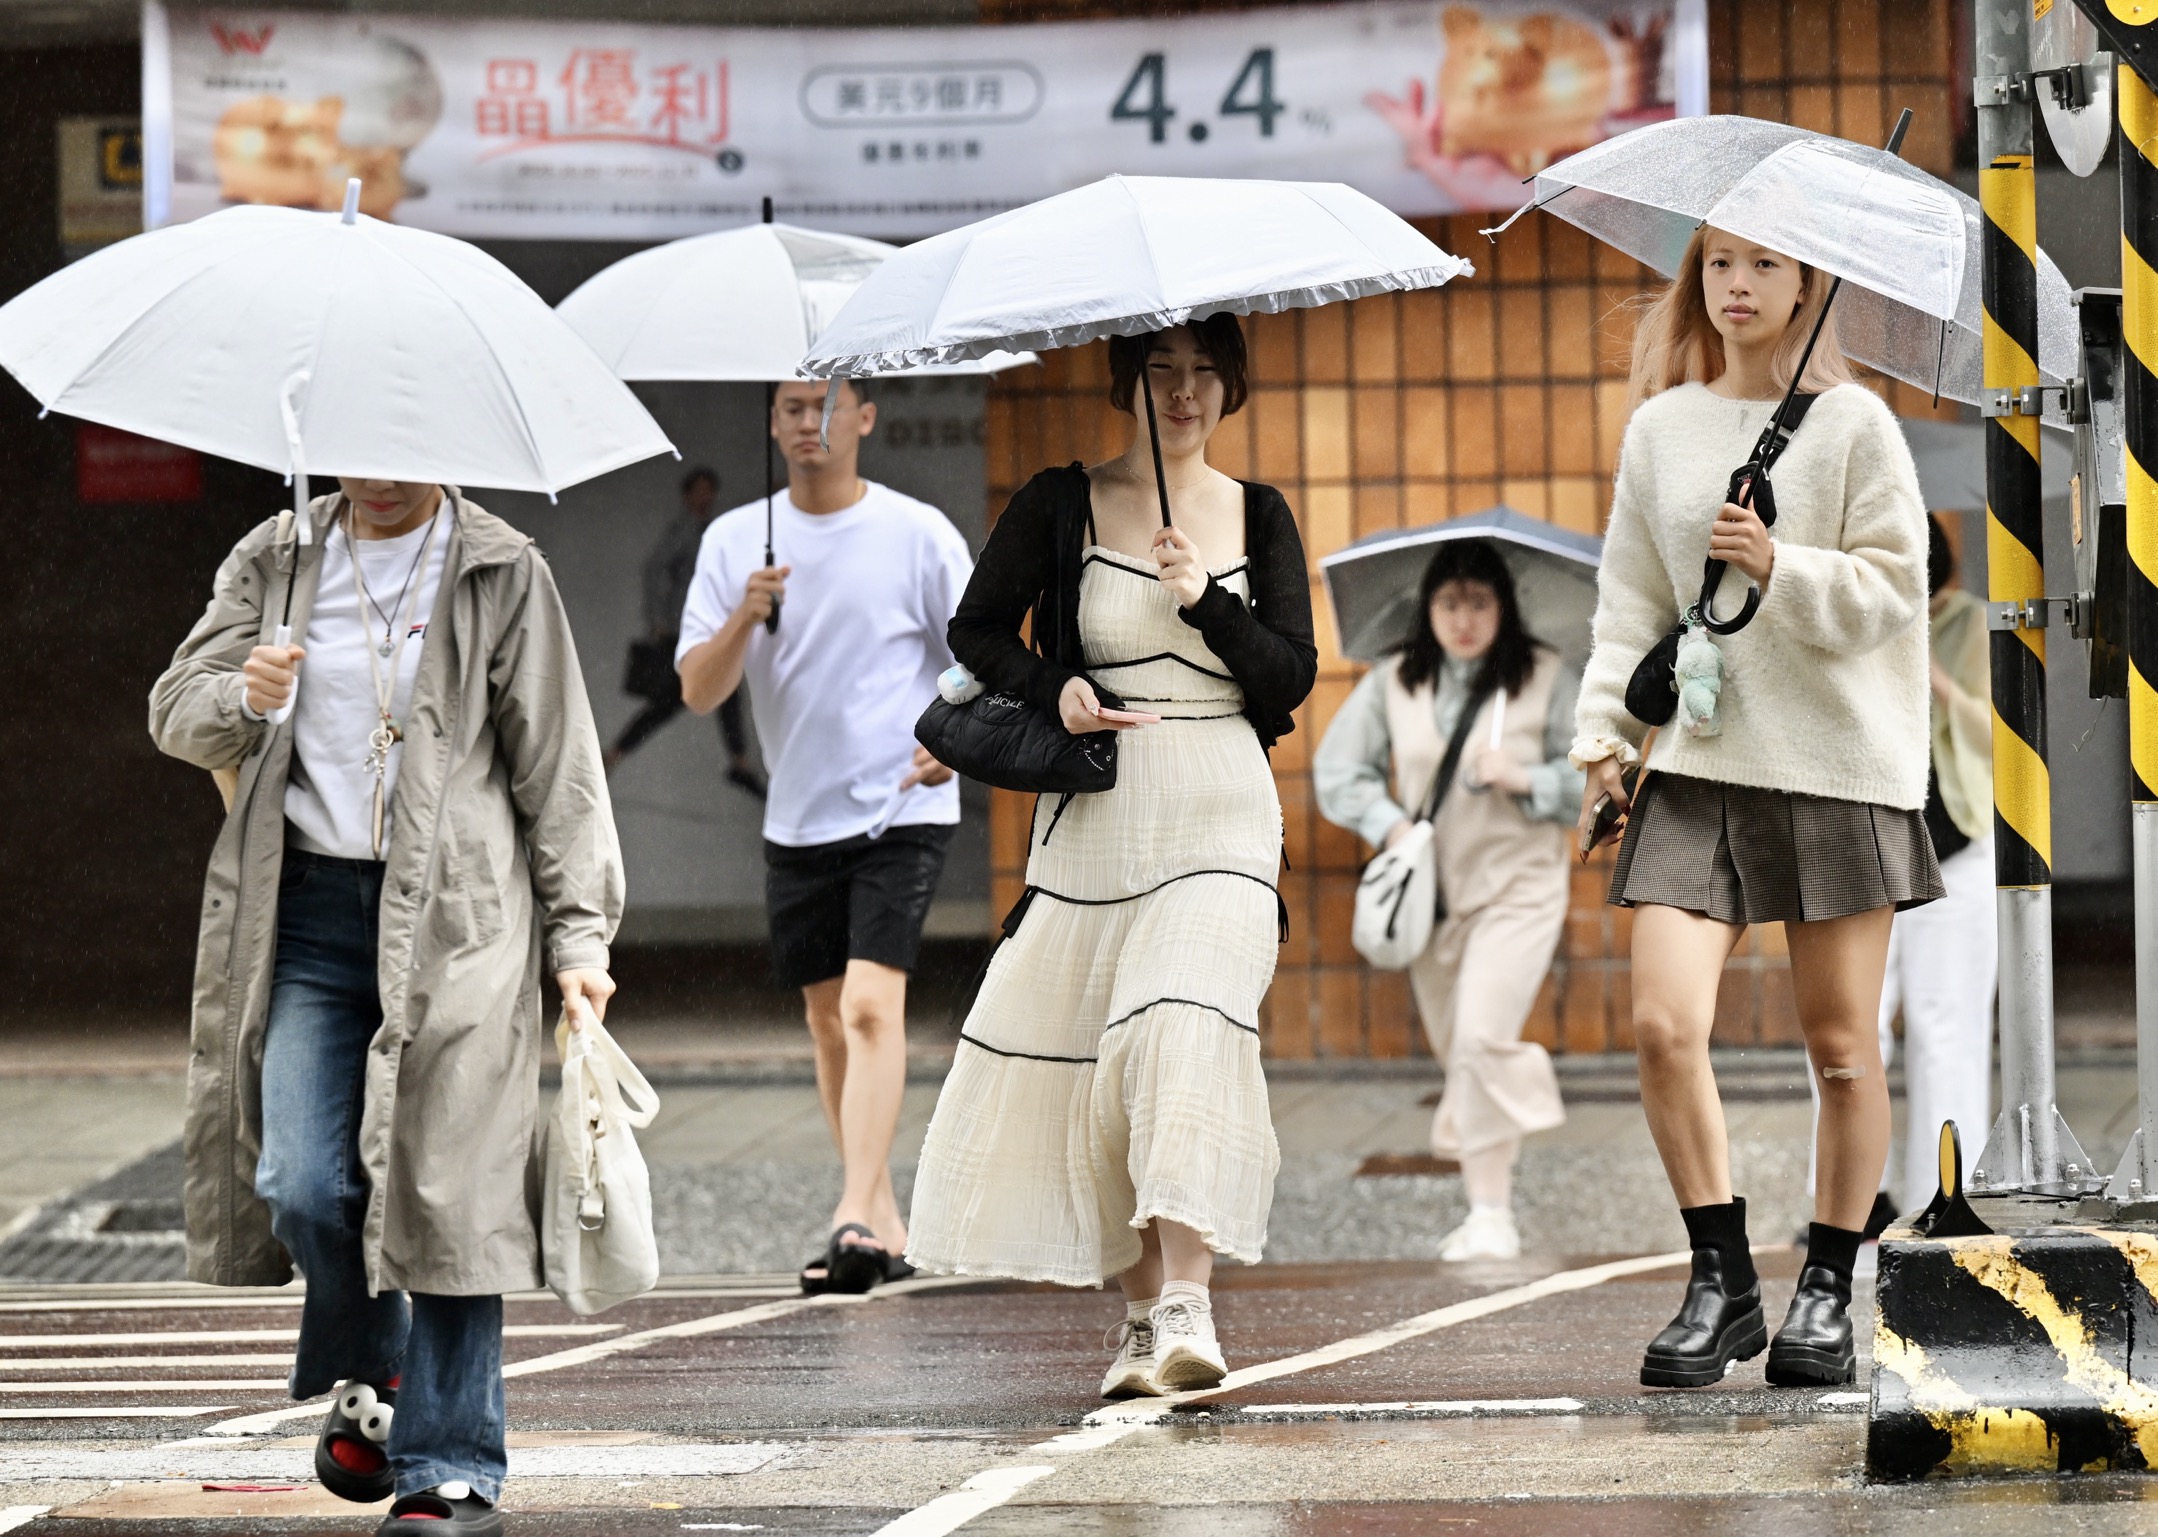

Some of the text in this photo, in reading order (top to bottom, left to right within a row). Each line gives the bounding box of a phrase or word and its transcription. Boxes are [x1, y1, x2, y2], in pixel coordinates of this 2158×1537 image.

[476, 48, 729, 145] 晶優利
[837, 75, 1002, 115] 美元9個月
